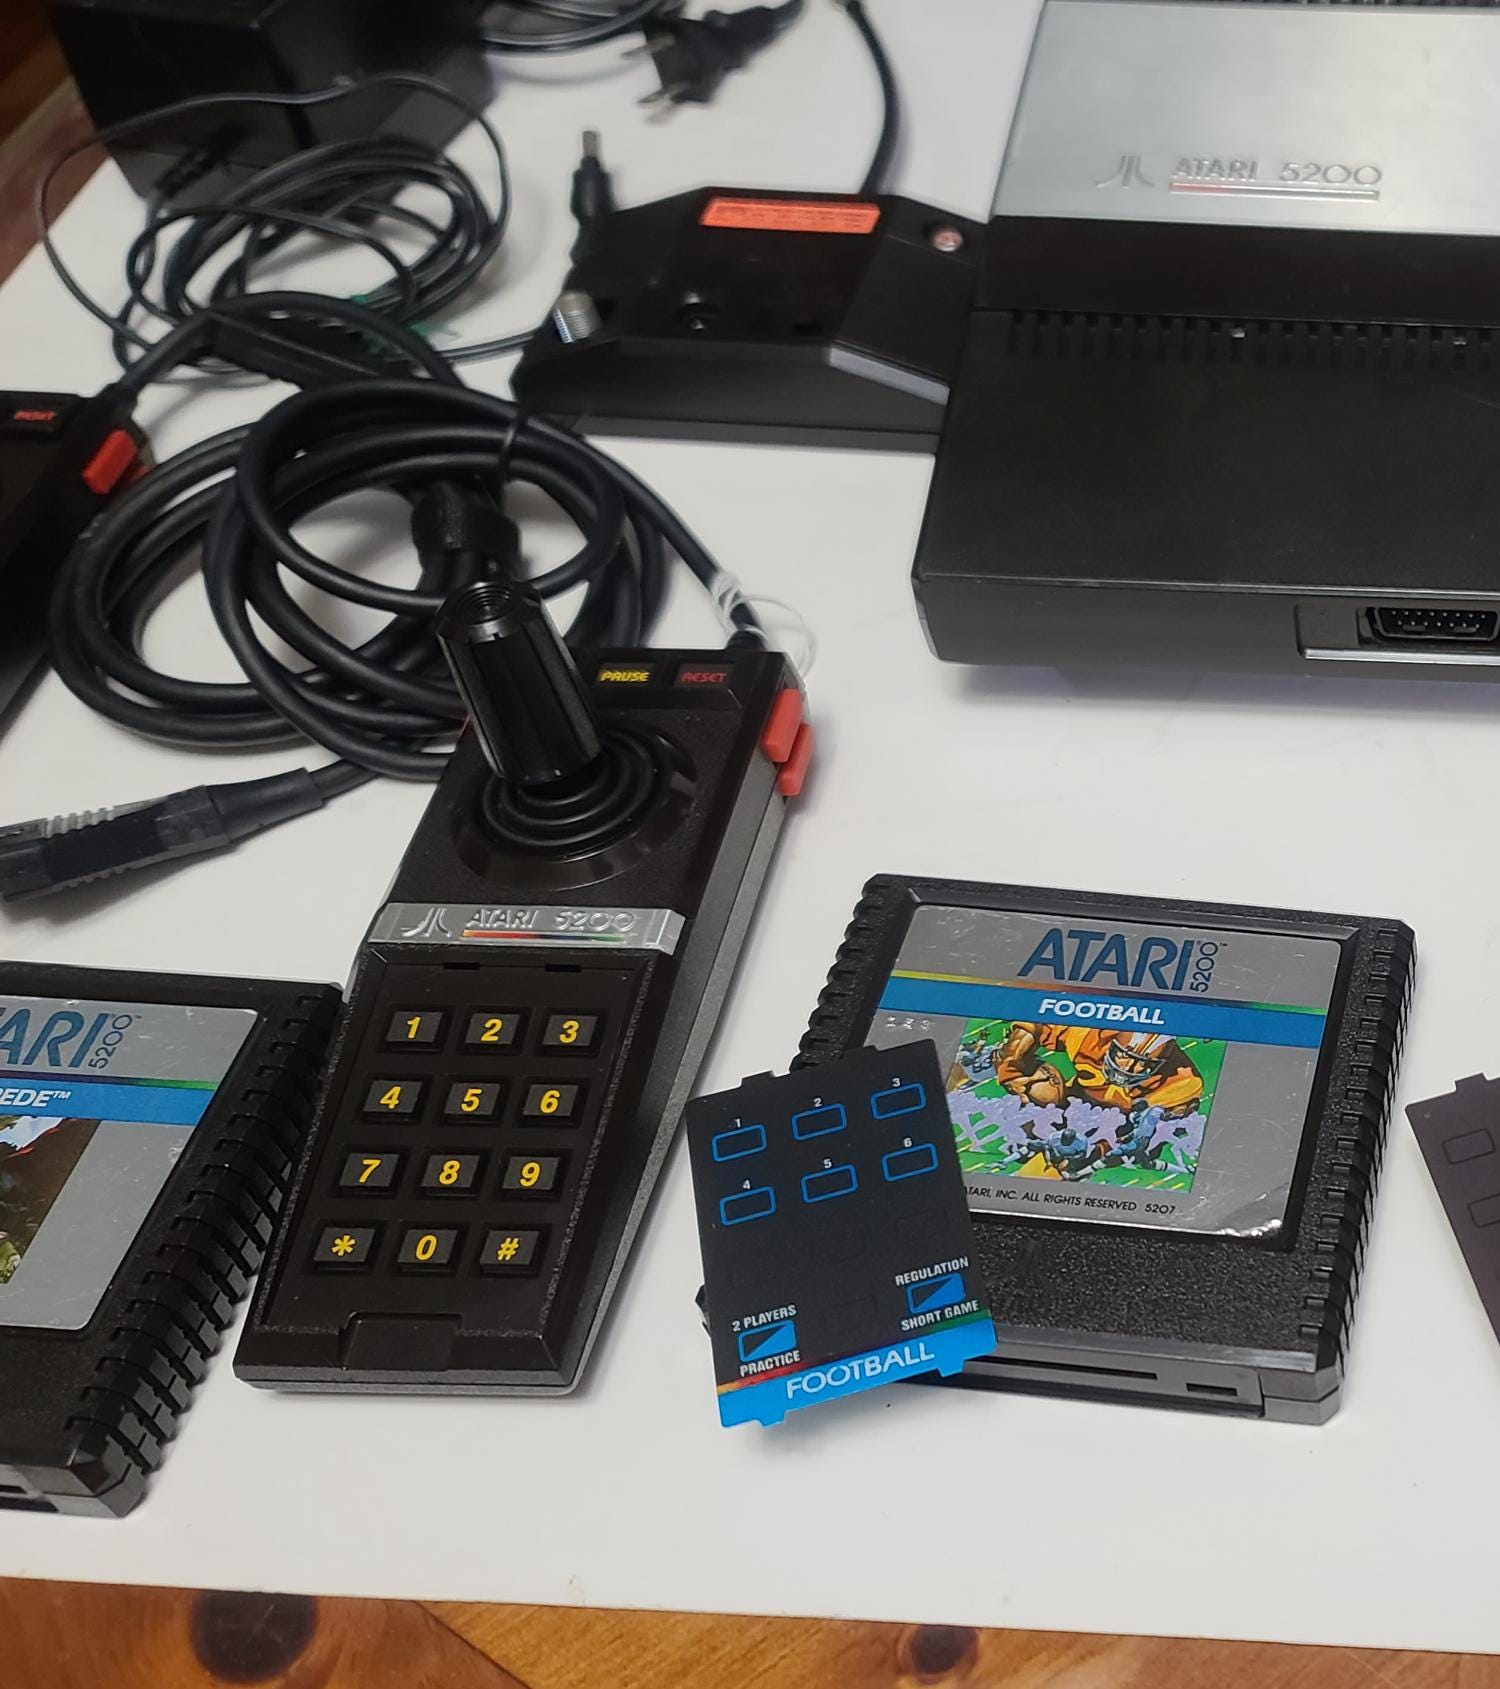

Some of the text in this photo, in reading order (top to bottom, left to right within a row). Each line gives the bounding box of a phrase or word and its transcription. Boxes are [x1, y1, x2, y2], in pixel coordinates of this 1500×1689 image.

[1172, 157, 1382, 185] ATARI 5200
[600, 671, 651, 682] PAUSE
[680, 672, 728, 683] RESET
[466, 908, 637, 932] ATARI 5200
[1039, 998, 1165, 1025] FOOTBALL
[0, 1007, 110, 1068] ARI
[406, 1016, 421, 1039] 1
[481, 1018, 502, 1041] 2
[559, 1020, 579, 1043] 3
[892, 1078, 901, 1087] 3
[379, 1086, 401, 1109] 4
[461, 1088, 482, 1112] 5
[540, 1090, 561, 1114] 6
[814, 1098, 822, 1108] 2
[735, 1119, 742, 1128] 1
[903, 1138, 912, 1148] 6
[358, 1159, 381, 1183] 7
[439, 1160, 460, 1185] 8
[520, 1162, 540, 1187] 9
[824, 1159, 832, 1169] 5
[743, 1180, 751, 1189] 4
[1021, 1192, 1040, 1202] ALL
[1043, 1193, 1081, 1206] RIGHTS
[1085, 1198, 1137, 1211] RESERVED
[1144, 1203, 1176, 1215] 5207
[415, 1235, 437, 1260] 0
[895, 1257, 969, 1286] REGULATION
[732, 1305, 797, 1332] 2 PLAYERS
[901, 1300, 979, 1332] SHORT GAME
[740, 1350, 801, 1377] PRACTICE
[787, 1343, 935, 1399] FOOTBALL
